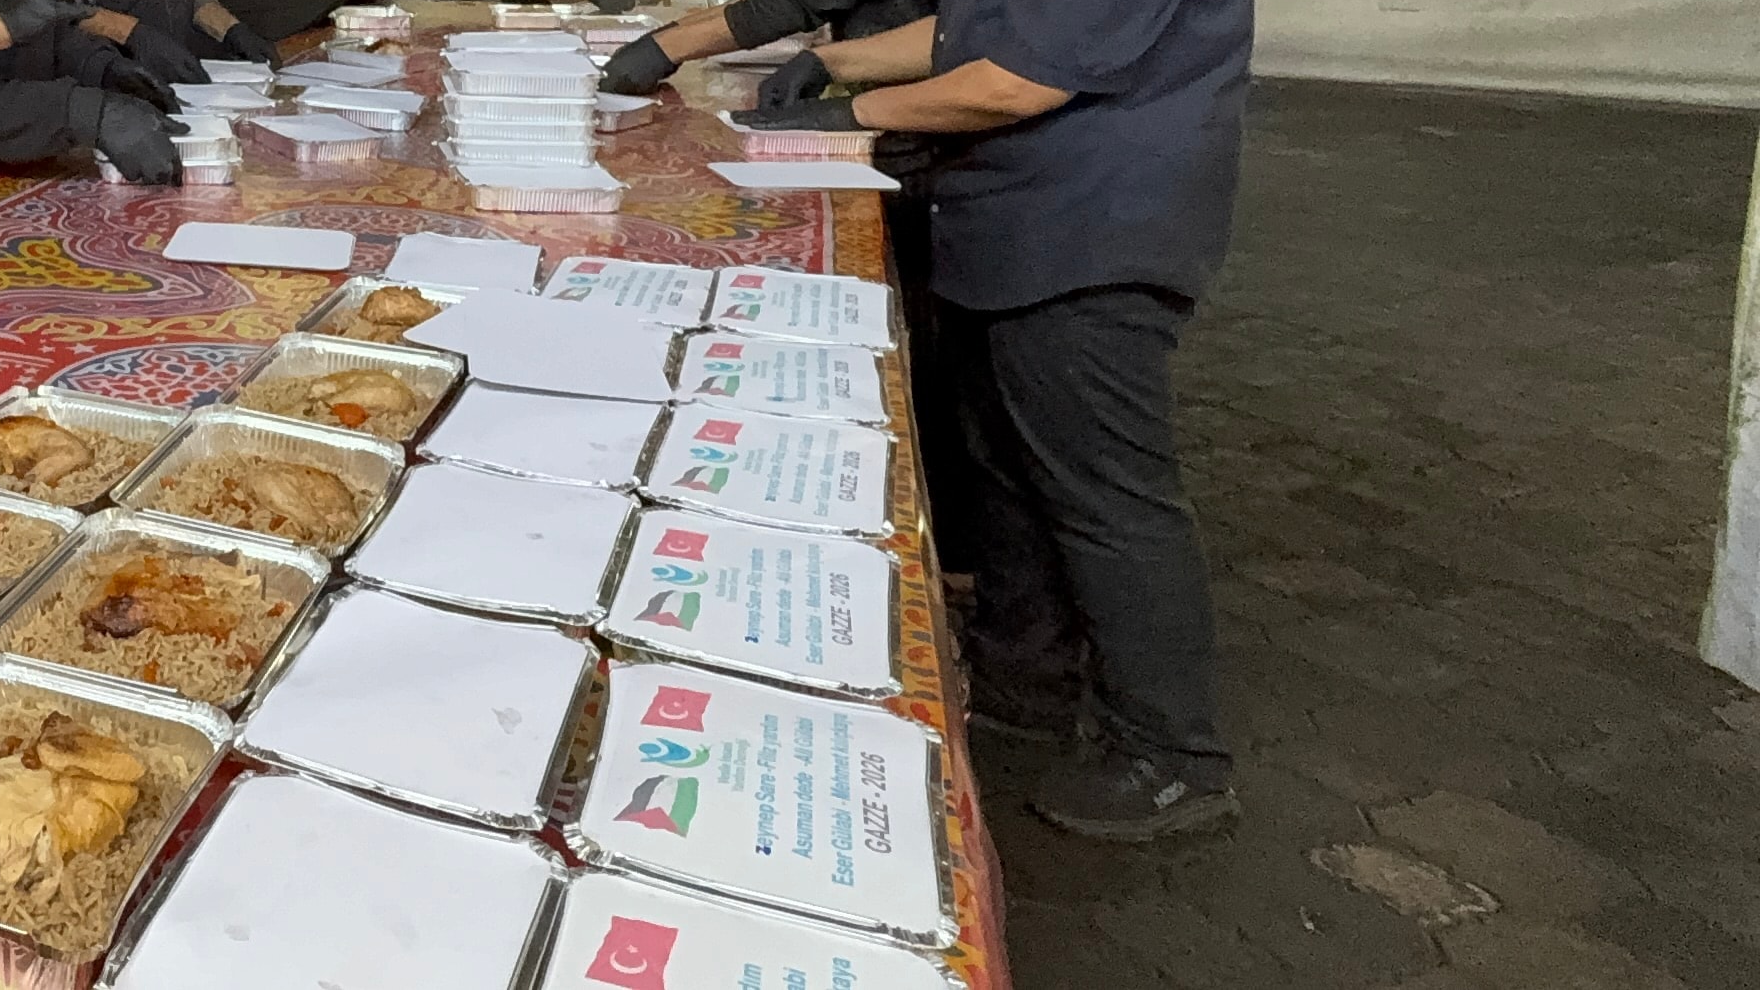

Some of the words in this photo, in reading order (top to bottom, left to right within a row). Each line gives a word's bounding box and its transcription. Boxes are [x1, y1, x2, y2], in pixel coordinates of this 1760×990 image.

[830, 573, 850, 600] 2026
[831, 606, 853, 646] GAZZE
[755, 773, 776, 802] Sare
[793, 771, 813, 802] dede
[830, 754, 850, 801] Mehmet
[860, 751, 886, 792] 2026
[792, 803, 813, 860] Asuman
[831, 808, 853, 851] Gülabi
[862, 798, 892, 854] GAZZE
[832, 851, 854, 887] Eser
